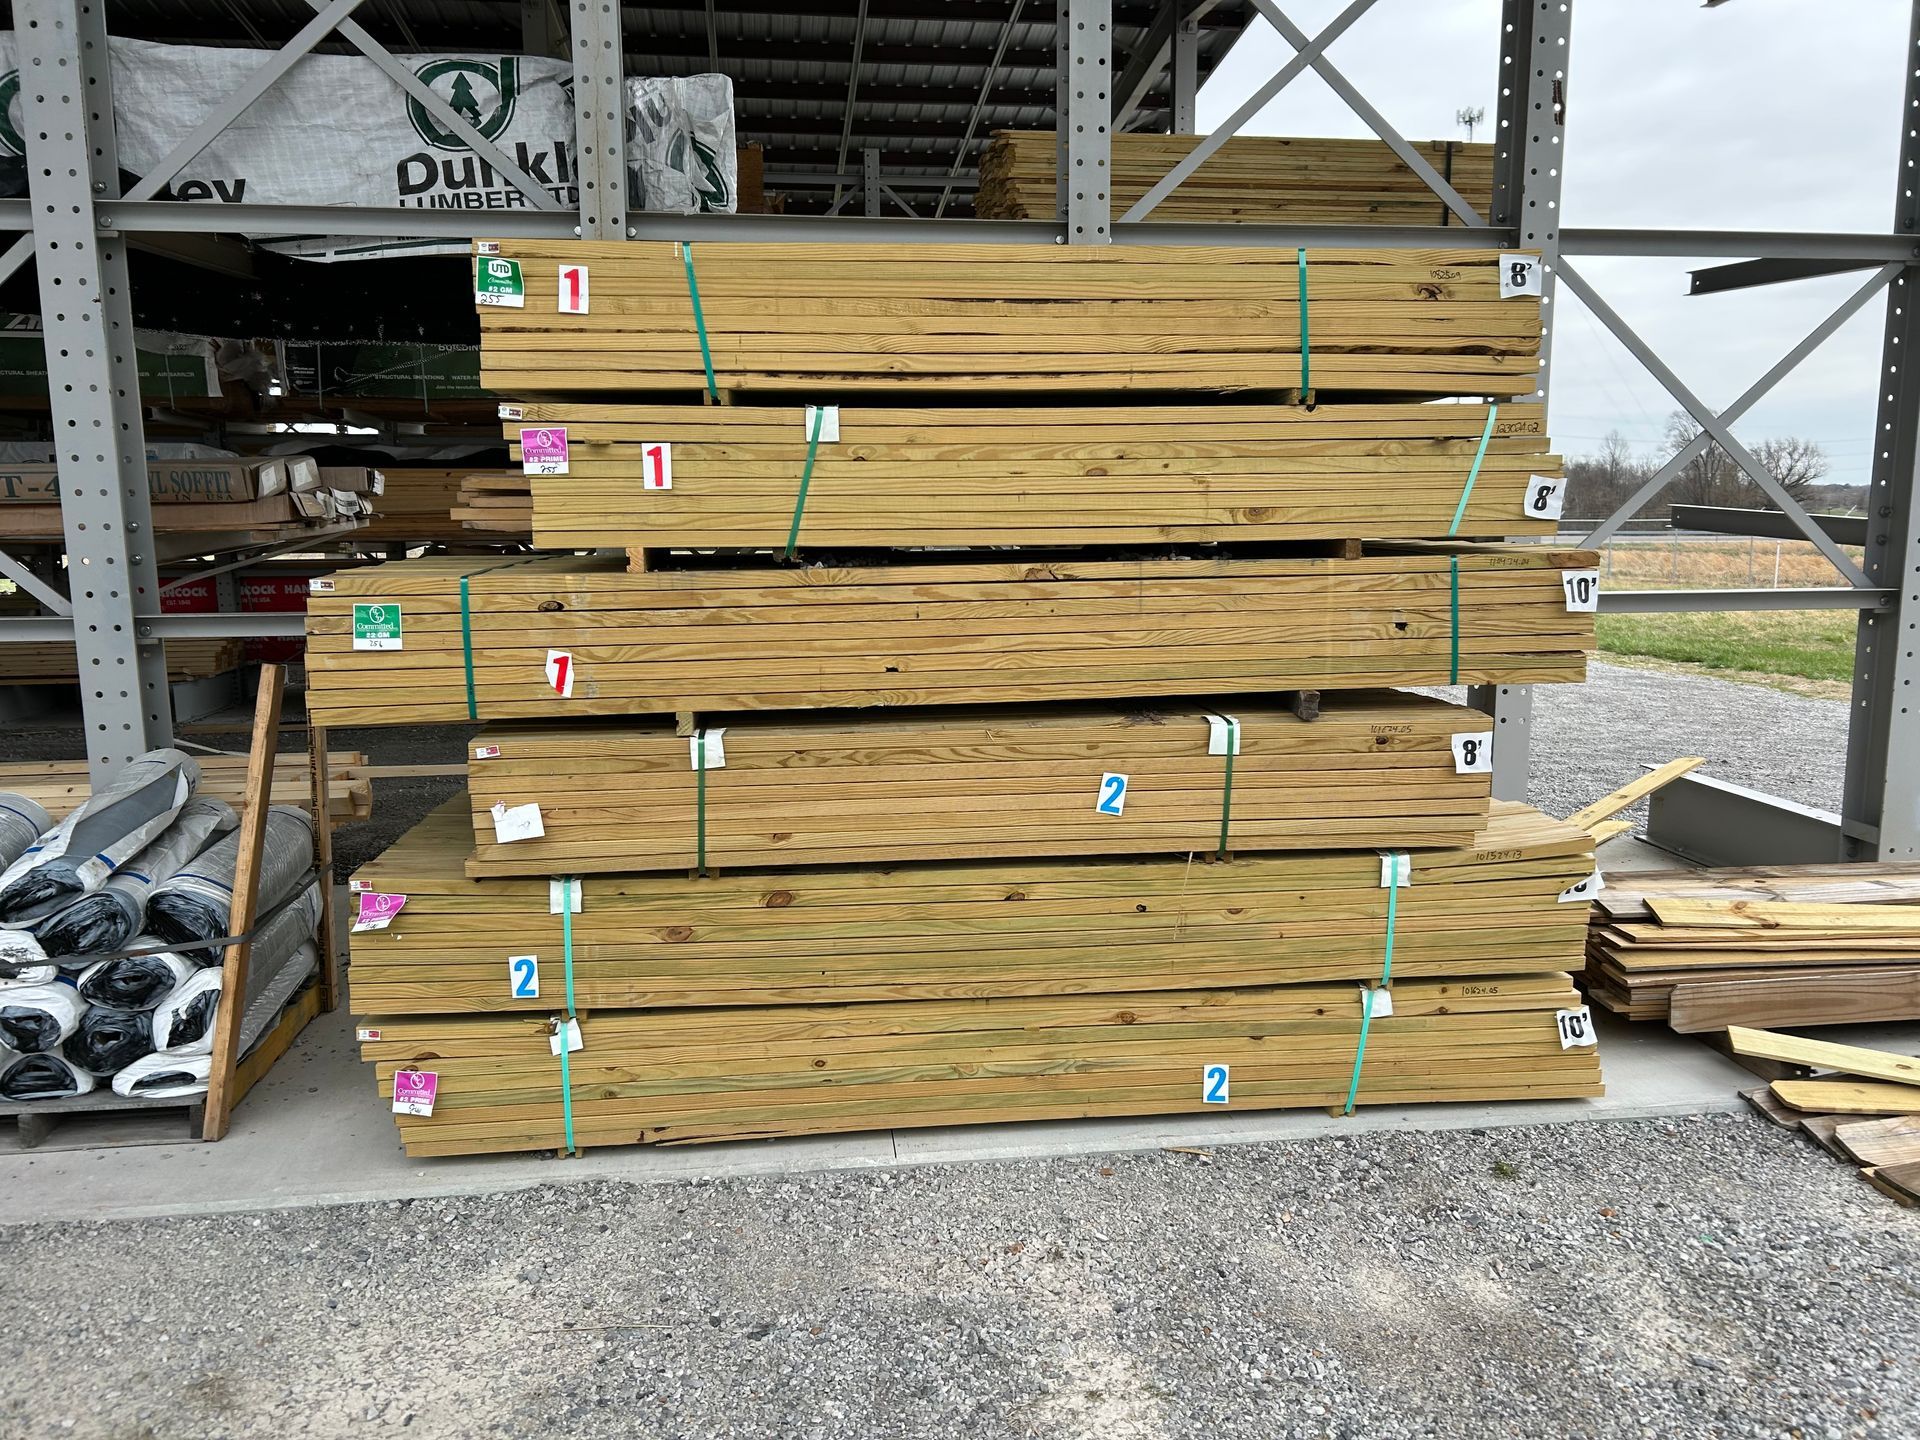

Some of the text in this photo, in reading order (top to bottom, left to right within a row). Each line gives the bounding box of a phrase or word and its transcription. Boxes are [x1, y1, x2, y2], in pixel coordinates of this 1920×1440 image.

[491, 263, 510, 274] UTD
[1510, 262, 1532, 288] 8'
[480, 293, 505, 304] 255
[500, 286, 513, 294] GM
[563, 268, 580, 311] 1
[646, 446, 664, 487] 1
[170, 470, 232, 495] SOFFIT
[1533, 485, 1557, 511] 8'
[1565, 577, 1597, 604] 10'
[356, 623, 394, 631] Committed
[553, 655, 570, 695] 1
[1462, 739, 1483, 766] 8'
[1100, 776, 1125, 814] 2
[514, 959, 536, 996] 2
[1559, 1012, 1588, 1040] 10'
[1206, 1067, 1227, 1101] 2
